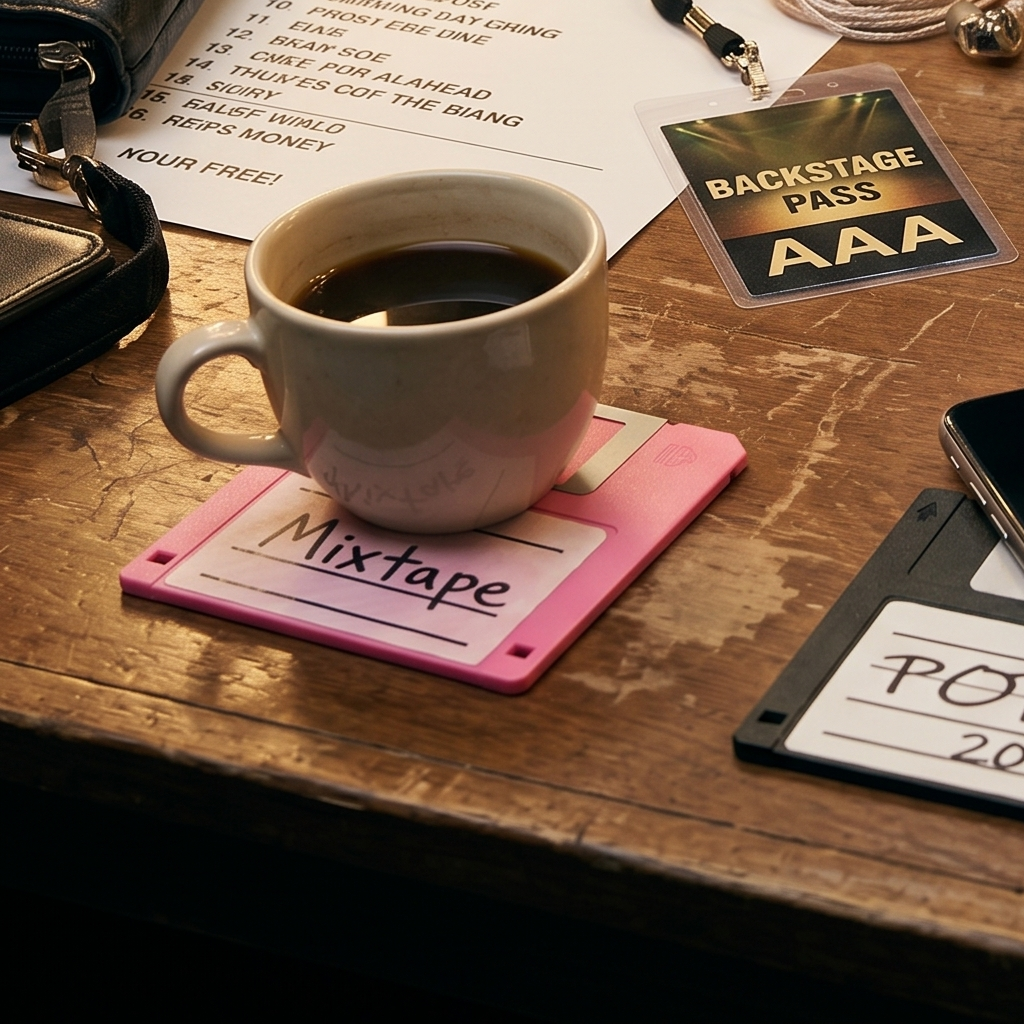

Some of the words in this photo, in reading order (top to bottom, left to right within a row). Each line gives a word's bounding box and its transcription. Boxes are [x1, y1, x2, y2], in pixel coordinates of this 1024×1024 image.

[434, 10, 484, 27] DAY
[226, 27, 253, 41] 12.
[337, 47, 392, 64] SOE
[184, 57, 214, 70] 14.
[391, 93, 441, 112] THE
[442, 104, 524, 128] BIANG
[372, 71, 493, 101] ALAHEAD
[127, 106, 148, 122] 6.
[238, 128, 336, 152] MONEY
[117, 147, 198, 171] NOUR
[199, 161, 284, 186] FREE!
[704, 146, 924, 201] BACKSTAGE
[781, 181, 882, 215] PASS
[768, 214, 964, 277] AAA
[258, 513, 511, 611] Mixtape
